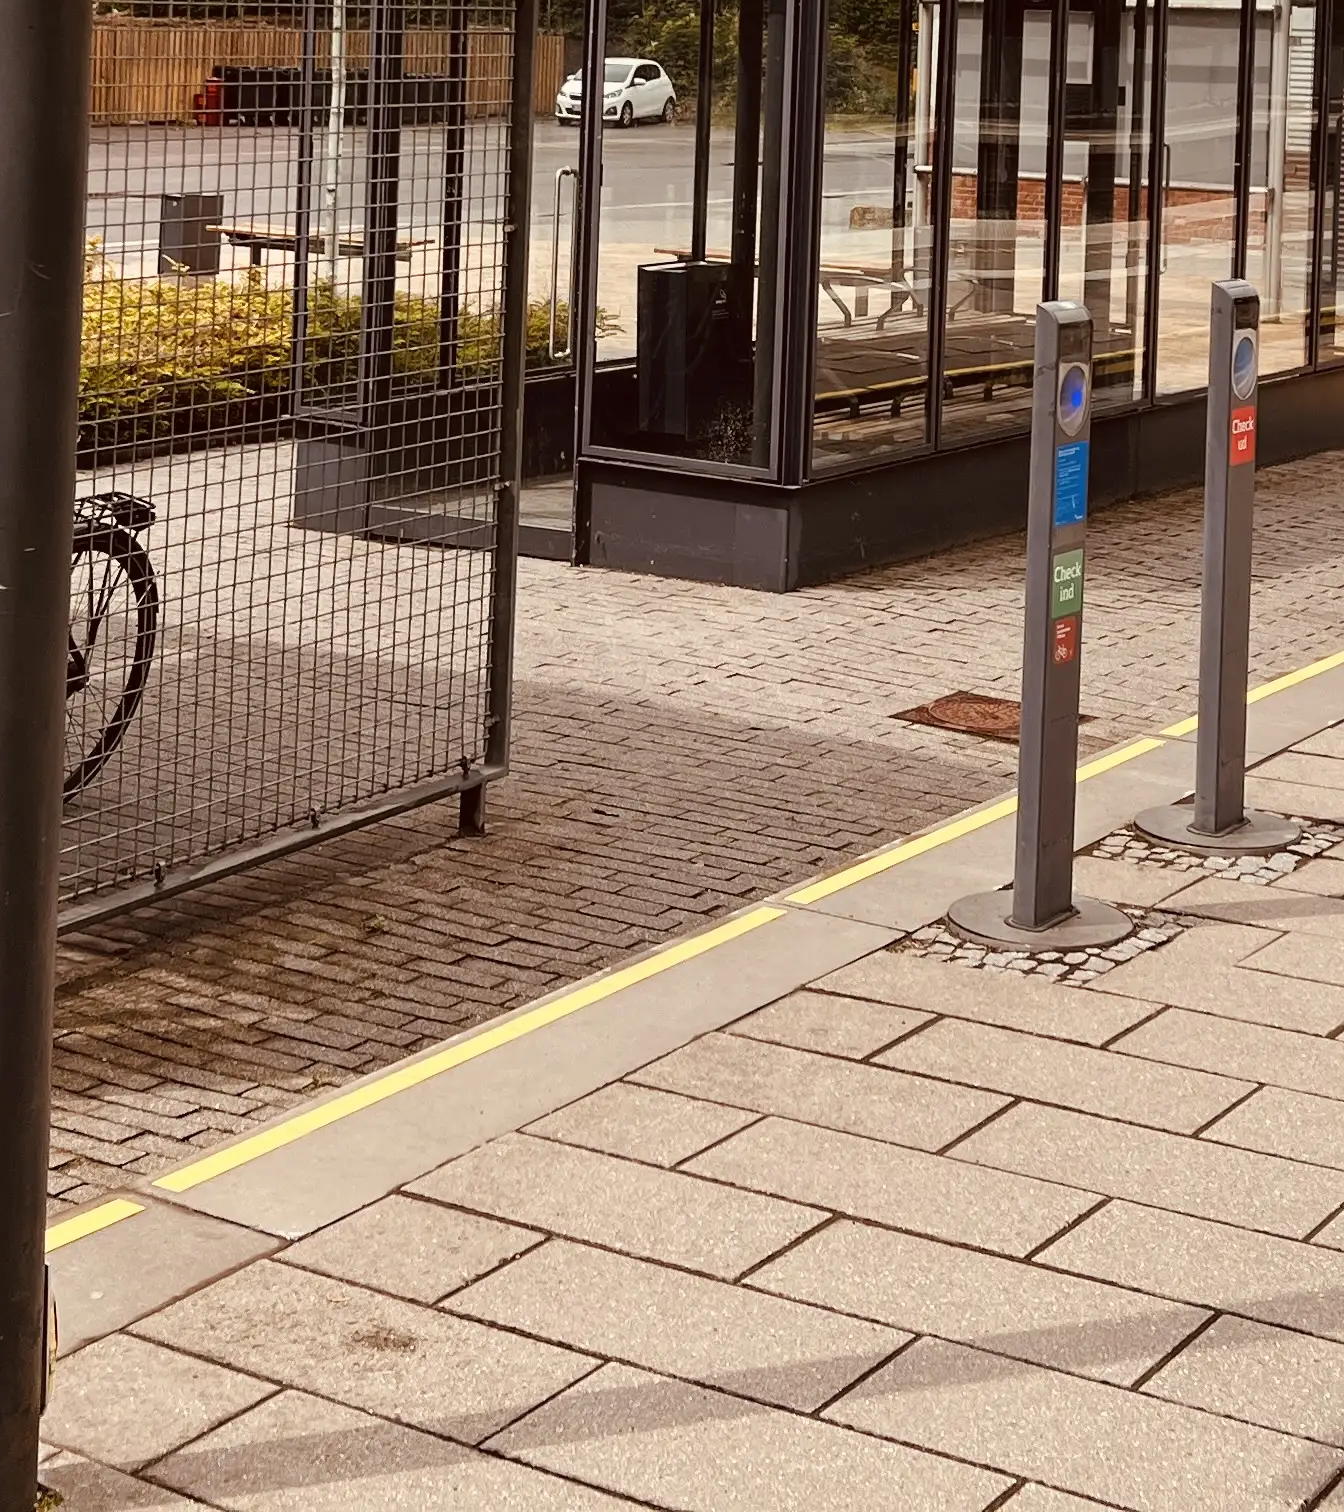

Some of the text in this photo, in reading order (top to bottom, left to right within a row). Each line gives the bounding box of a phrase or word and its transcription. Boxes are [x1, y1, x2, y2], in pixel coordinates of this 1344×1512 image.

[1232, 416, 1254, 434] Check
[1237, 435, 1247, 450] ud
[1054, 562, 1082, 583] Check
[1059, 583, 1074, 602] ind
